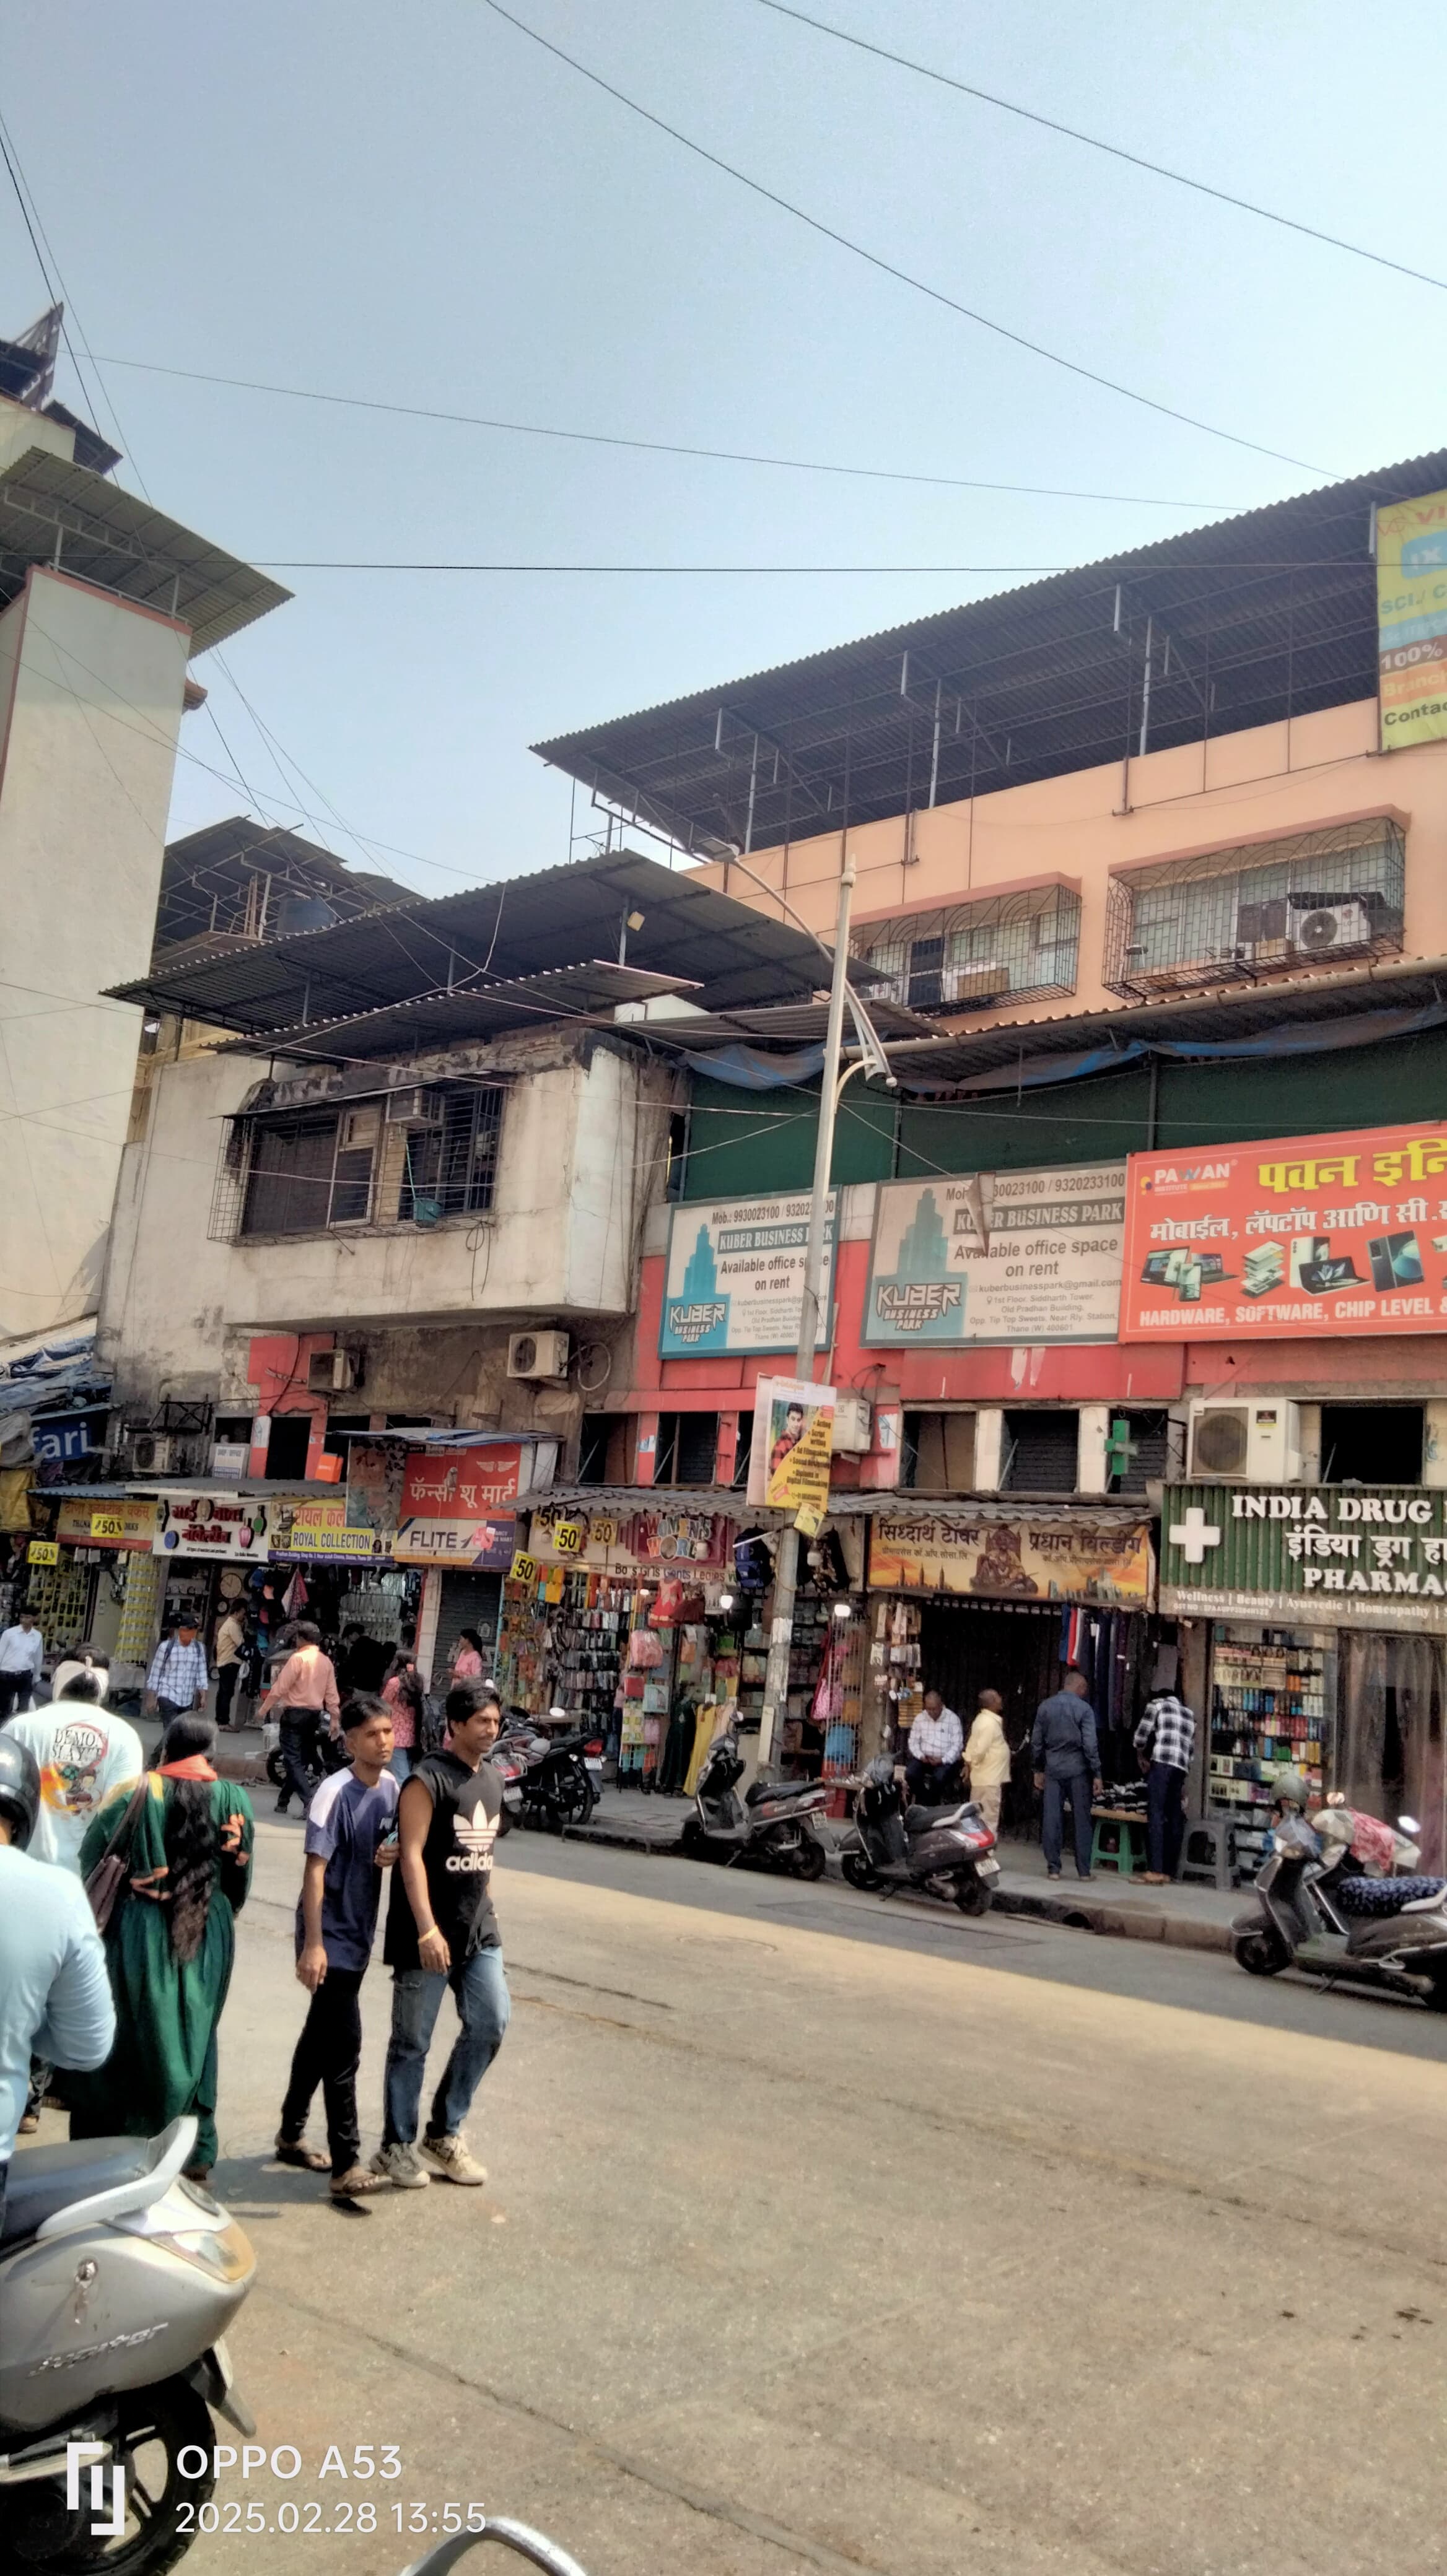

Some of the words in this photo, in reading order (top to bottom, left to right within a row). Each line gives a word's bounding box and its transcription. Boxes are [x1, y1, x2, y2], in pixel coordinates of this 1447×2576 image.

[1381, 642, 1443, 671] 100%
[1154, 1162, 1229, 1181] PAWAN
[1258, 1155, 1361, 1193] पवन
[1055, 1173, 1126, 1193] 9320233100
[734, 1207, 779, 1222] 9930023100
[786, 1199, 834, 1217] 9320200
[1007, 1206, 1078, 1227] BUSINESS
[1082, 1201, 1123, 1222] PARK
[1245, 1207, 1318, 1235] लॅपटॉप
[1322, 1201, 1391, 1229] आणि
[719, 1233, 752, 1251] KUBER
[754, 1227, 803, 1247] BUSINESS
[1025, 1239, 1066, 1256] office
[1072, 1237, 1118, 1255] space
[720, 1258, 764, 1274] Available
[767, 1255, 796, 1270] office
[1005, 1266, 1024, 1277] on
[1028, 1260, 1059, 1276] rent
[754, 1280, 766, 1291] on
[769, 1275, 790, 1289] rent
[877, 1282, 963, 1316] KUBER
[1016, 1305, 1047, 1313] Pradhan
[670, 1302, 726, 1333] KUBER
[1140, 1307, 1230, 1326] HARDWARE,
[1236, 1303, 1329, 1324] SOFTWARE,
[1335, 1300, 1375, 1318] CHIP
[1381, 1298, 1433, 1316] LEVEL
[32, 1421, 88, 1459] fari
[460, 1484, 478, 1508] शू
[481, 1478, 516, 1503] मार्ट
[1231, 1495, 1328, 1519] INDIA
[1337, 1498, 1433, 1523] DRUG
[101, 1520, 116, 1534] 50
[594, 1523, 612, 1543] 50
[293, 1531, 318, 1548] ROYAL
[321, 1533, 371, 1550] COLLECTION
[409, 1531, 458, 1549] FLITE
[559, 1528, 577, 1549] 50
[647, 1536, 707, 1560] WORL
[1030, 1532, 1073, 1551] प्रधान
[1285, 1524, 1362, 1562] इंडिया
[1370, 1536, 1413, 1568] ड्रग
[37, 1548, 48, 1560] 50
[516, 1558, 534, 1580] 50
[1303, 1567, 1447, 1596] PHARMA
[1176, 1590, 1225, 1603] Wellness
[1236, 1593, 1275, 1609] Beauty
[1287, 1597, 1343, 1611] Ayurvedic
[1355, 1601, 1430, 1619] Homeopathy
[445, 1852, 494, 1871] adida
